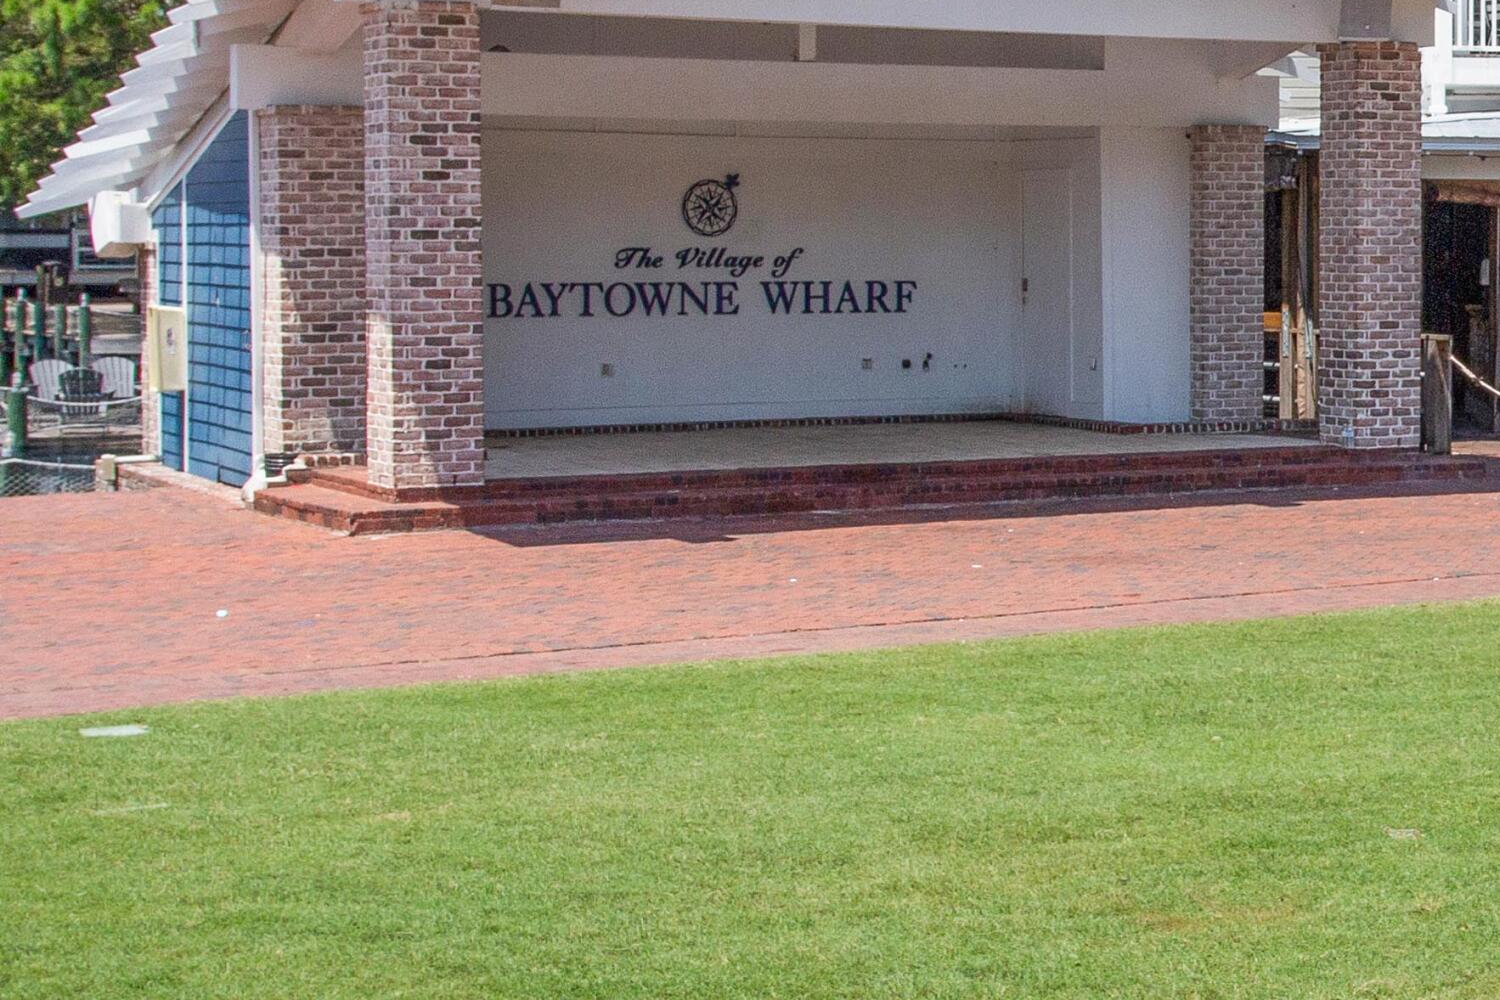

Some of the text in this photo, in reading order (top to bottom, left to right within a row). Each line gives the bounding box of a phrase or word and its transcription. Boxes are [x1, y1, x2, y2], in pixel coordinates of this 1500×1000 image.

[614, 247, 804, 278] The Village of
[486, 280, 918, 318] BAYTOWNE WHARF
